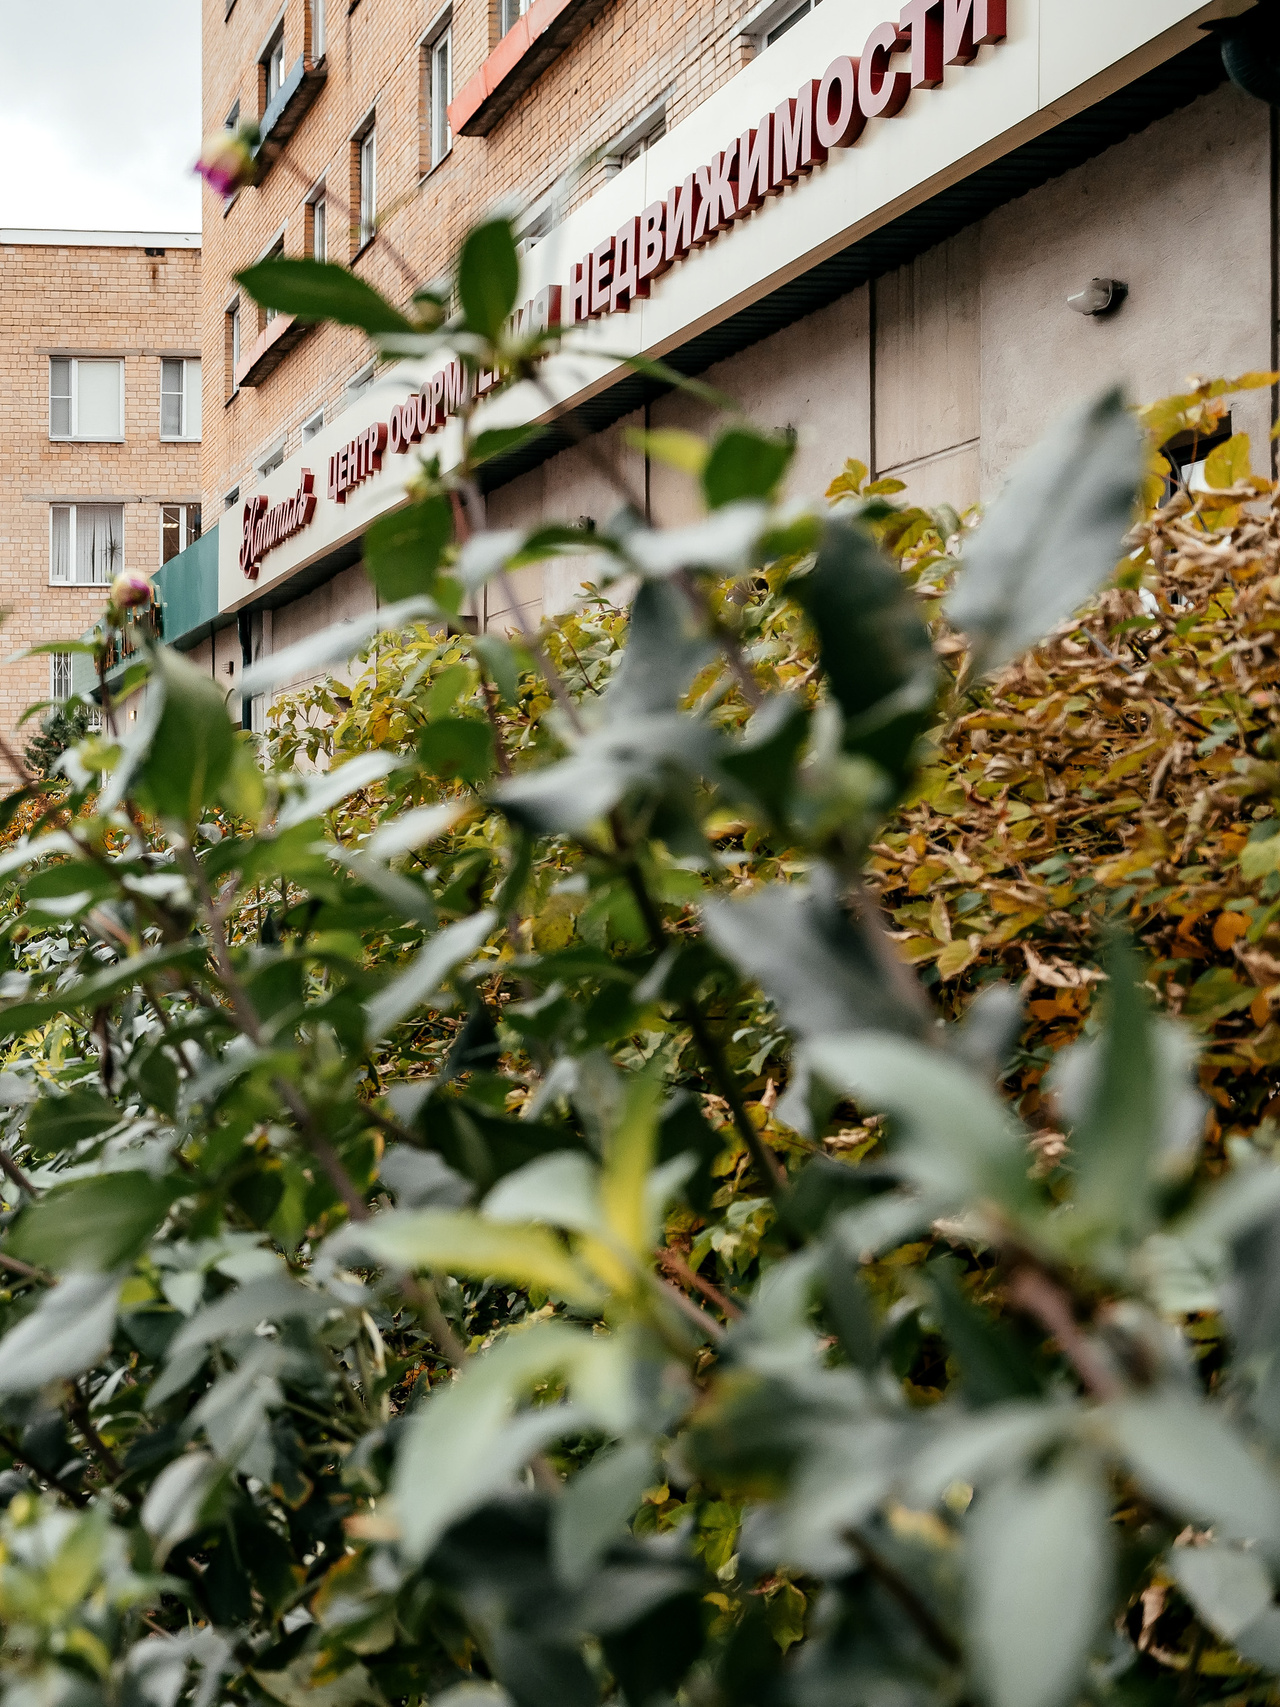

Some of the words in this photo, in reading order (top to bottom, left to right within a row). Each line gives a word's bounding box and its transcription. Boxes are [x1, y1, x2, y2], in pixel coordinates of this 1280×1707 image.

[327, 421, 388, 504] ЦЕНТР
[389, 285, 562, 455] ОФОРМЛЯ
[570, 0, 1007, 325] НЕДВИЖИМОСТИ
